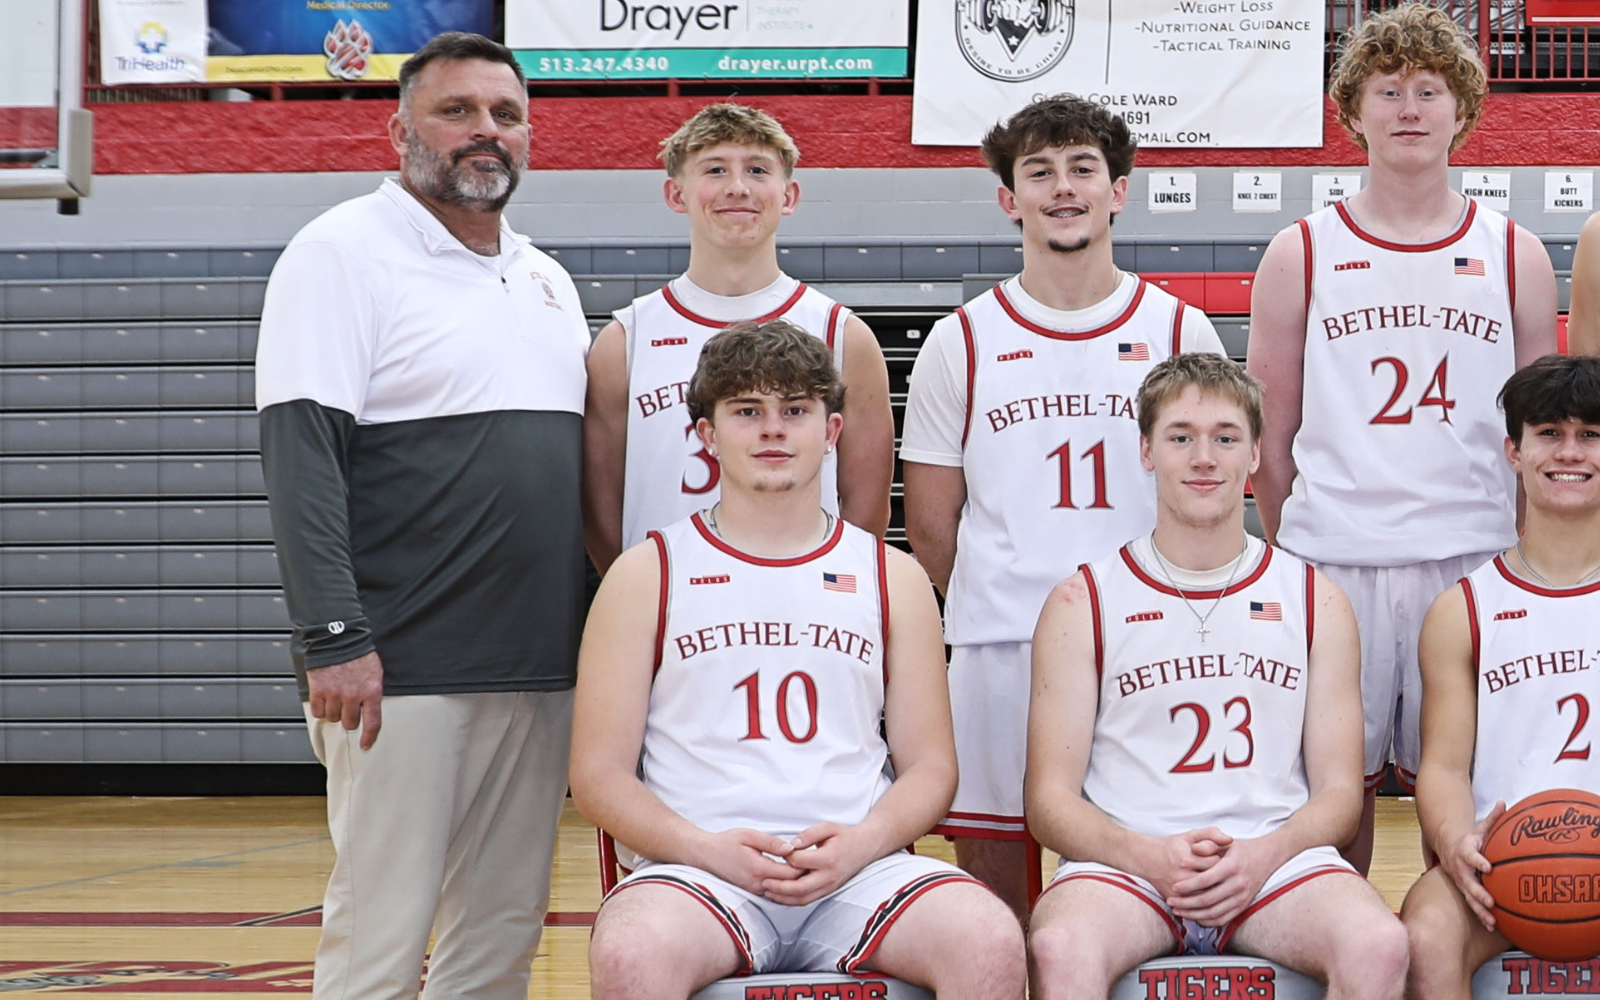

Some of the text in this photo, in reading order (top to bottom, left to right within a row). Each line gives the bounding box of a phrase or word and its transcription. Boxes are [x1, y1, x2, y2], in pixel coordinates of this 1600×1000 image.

[1241, 0, 1274, 13] LOSS
[599, 0, 738, 40] Drayer
[1135, 19, 1311, 33] -NUTRITIONAL GUIDANCE
[1153, 38, 1291, 52] -TACTICAL TRAINING
[114, 56, 185, 71] TriHealth
[539, 56, 670, 73] 513.247.4340
[718, 55, 873, 74] drayer.urpt.com
[1133, 94, 1178, 106] WARD
[1129, 132, 1210, 144] GMAIL.COM
[1253, 176, 1262, 186] 2.
[1154, 192, 1192, 204] LUNGES
[1329, 188, 1344, 196] SIDE
[1484, 188, 1507, 198] KNEES
[1559, 187, 1578, 196] BUTT
[1554, 199, 1583, 208] KICKERS
[1321, 304, 1502, 344] BETHEL-TATE
[1368, 350, 1457, 427] 24
[985, 393, 1139, 434] BETHEL-TA
[681, 422, 722, 494] 3
[1045, 436, 1115, 511] 11
[674, 622, 874, 665] BETHEL-TATE
[1115, 652, 1302, 698] BETHEL-TATE
[732, 668, 819, 743] 10
[1168, 696, 1255, 774] 23
[1553, 693, 1592, 765] 2
[1138, 966, 1277, 1000] TIGERS
